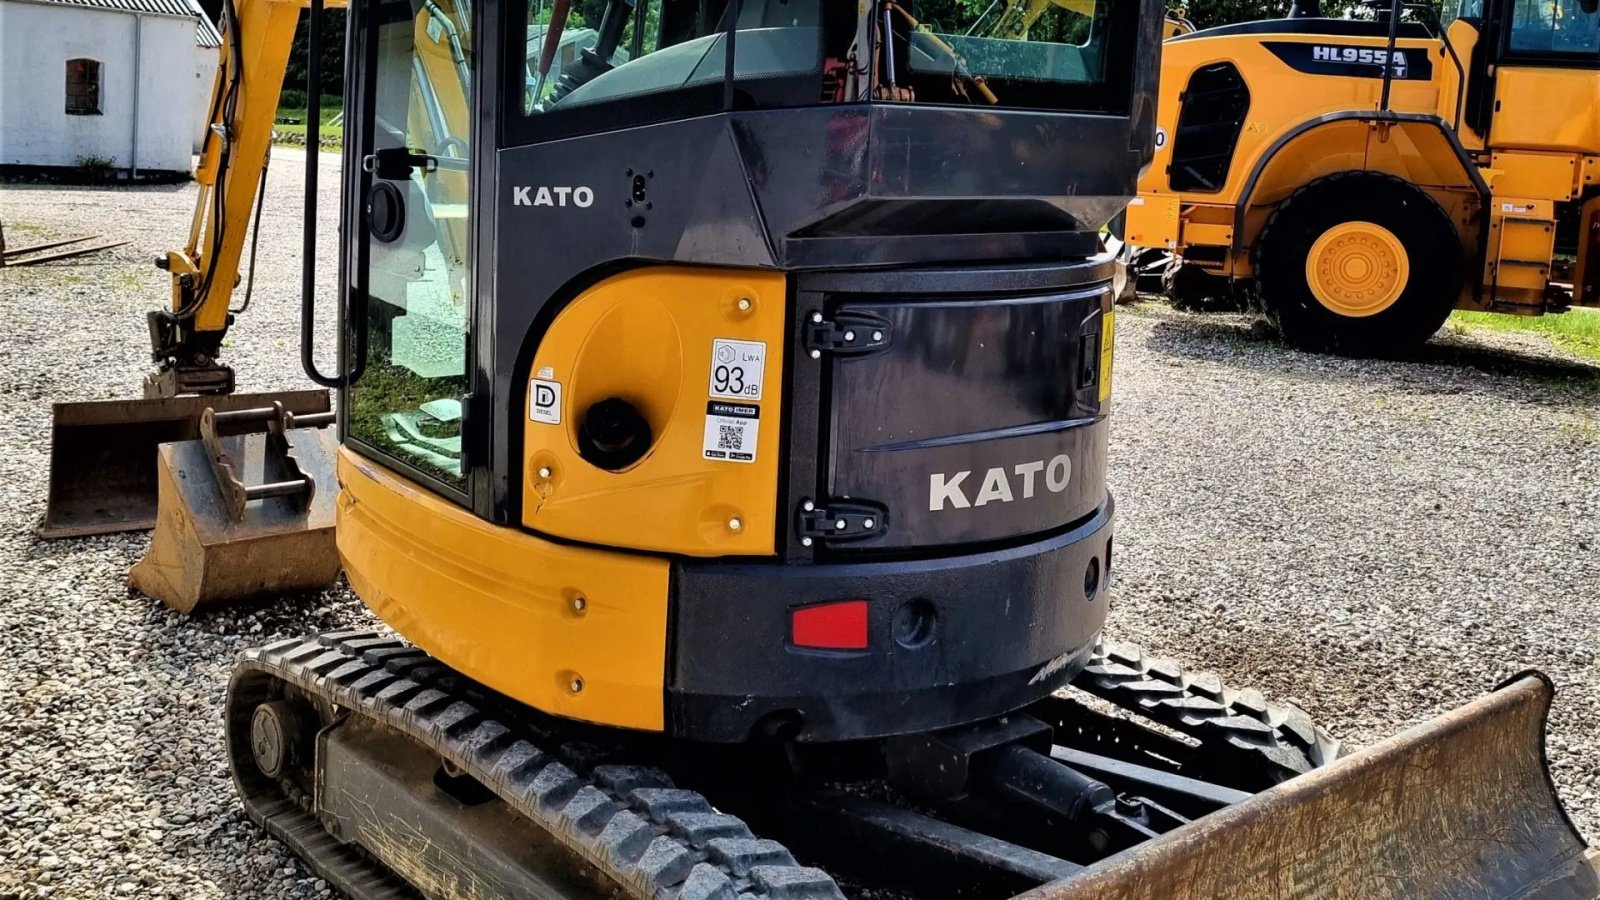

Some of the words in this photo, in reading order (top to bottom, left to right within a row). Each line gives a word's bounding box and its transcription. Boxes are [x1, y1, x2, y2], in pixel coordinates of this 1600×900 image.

[1313, 46, 1406, 65] HL955A
[513, 186, 594, 208] KATO
[714, 365, 744, 394] 93
[744, 384, 758, 396] dB
[536, 408, 552, 416] DIESEL
[929, 453, 1072, 511] KATO
